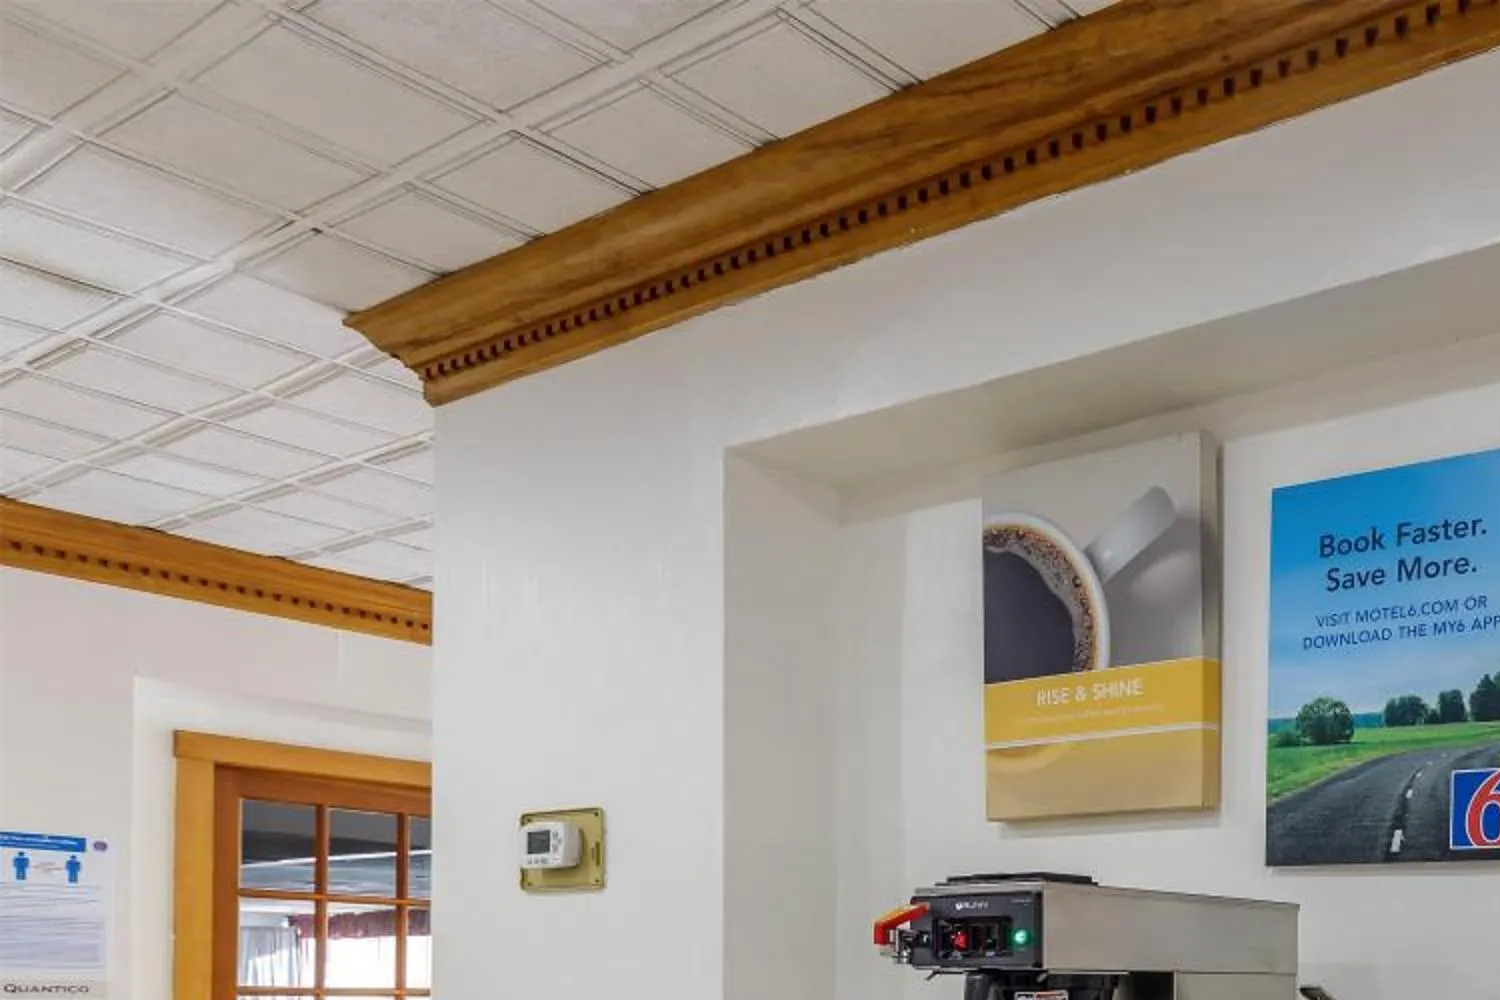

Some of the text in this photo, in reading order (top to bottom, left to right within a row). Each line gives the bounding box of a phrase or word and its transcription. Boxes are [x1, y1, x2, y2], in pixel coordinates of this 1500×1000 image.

[1318, 517, 1488, 558] Book Faster.
[1326, 556, 1478, 592] Save More.
[1316, 595, 1488, 627] VISIT MOTEL6.COM OR
[1303, 627, 1393, 650] DOWNLOAD
[1400, 623, 1428, 639] THE
[1433, 621, 1466, 636] MY6
[1036, 678, 1144, 706] RISE & SHINE
